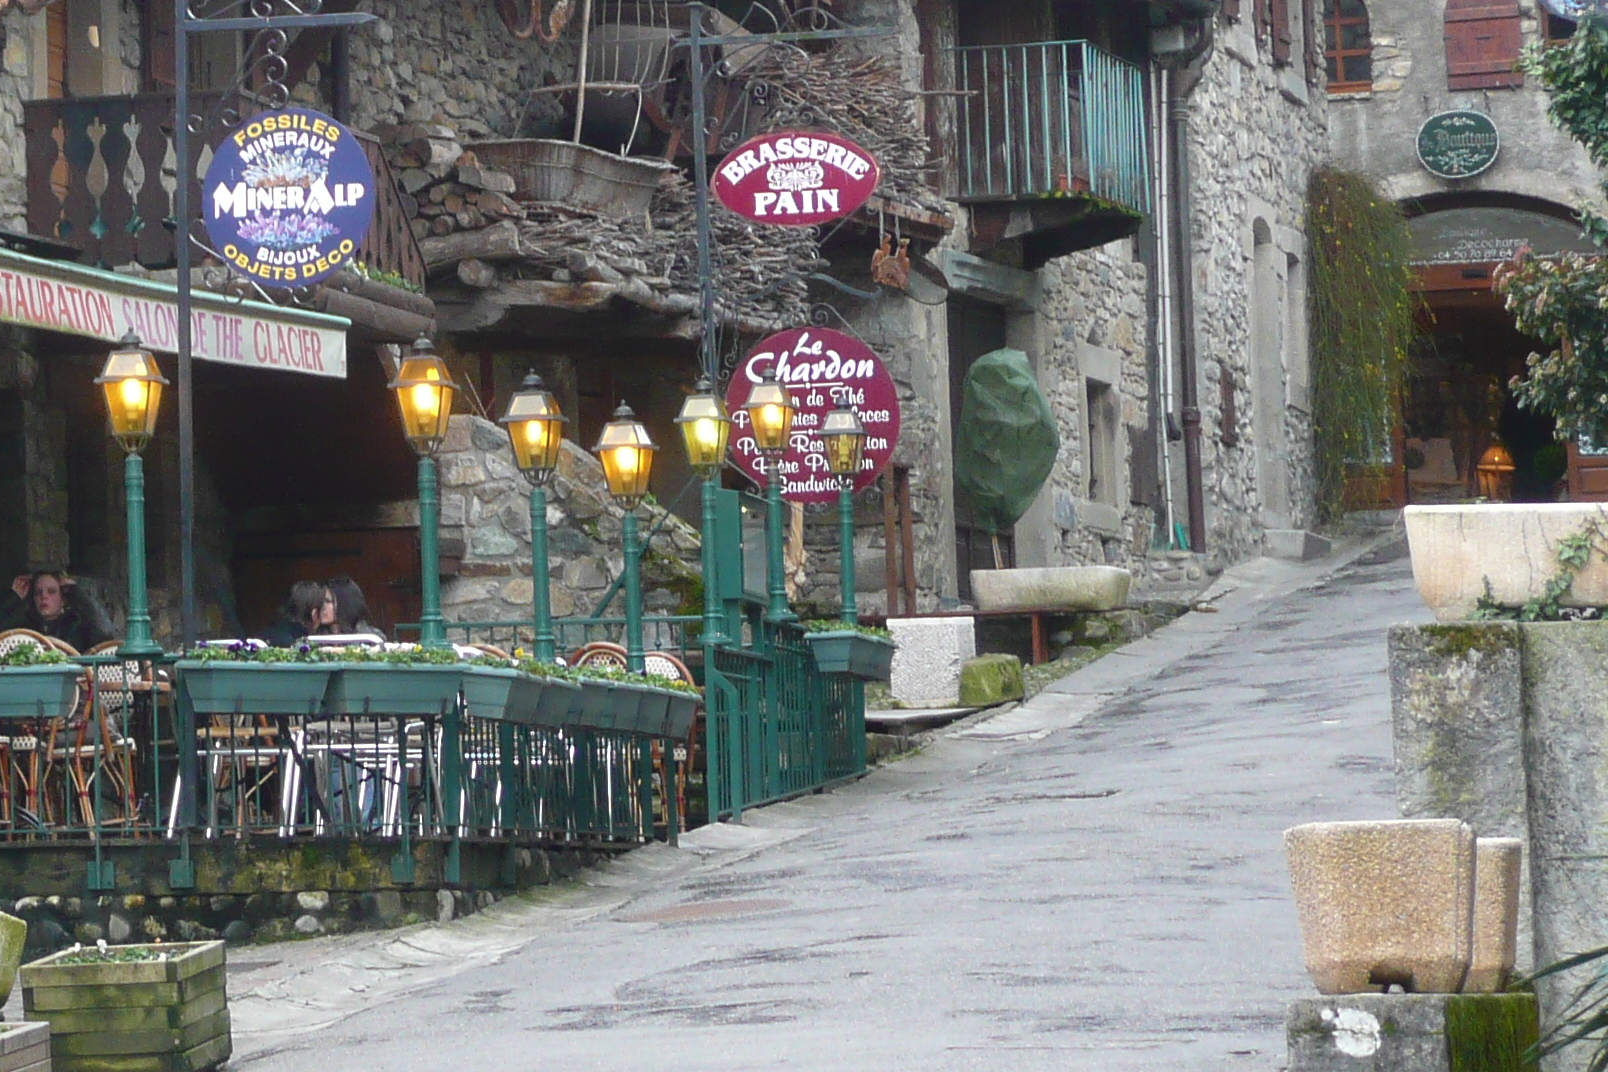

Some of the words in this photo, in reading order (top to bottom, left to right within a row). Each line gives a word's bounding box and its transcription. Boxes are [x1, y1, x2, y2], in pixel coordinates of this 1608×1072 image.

[233, 114, 340, 147] FOSSILES
[239, 131, 335, 163] MINERAUX
[721, 137, 870, 186] BRASSERIE
[754, 189, 840, 216] PAIN
[224, 244, 297, 280] OBJETS
[302, 239, 354, 278] DECO
[256, 244, 321, 266] BIJOUX
[213, 314, 243, 360] THE
[253, 320, 324, 371] GLACIER
[793, 332, 823, 357] Le
[745, 349, 874, 384] Chardon
[807, 389, 824, 407] de
[829, 386, 865, 408] Thé
